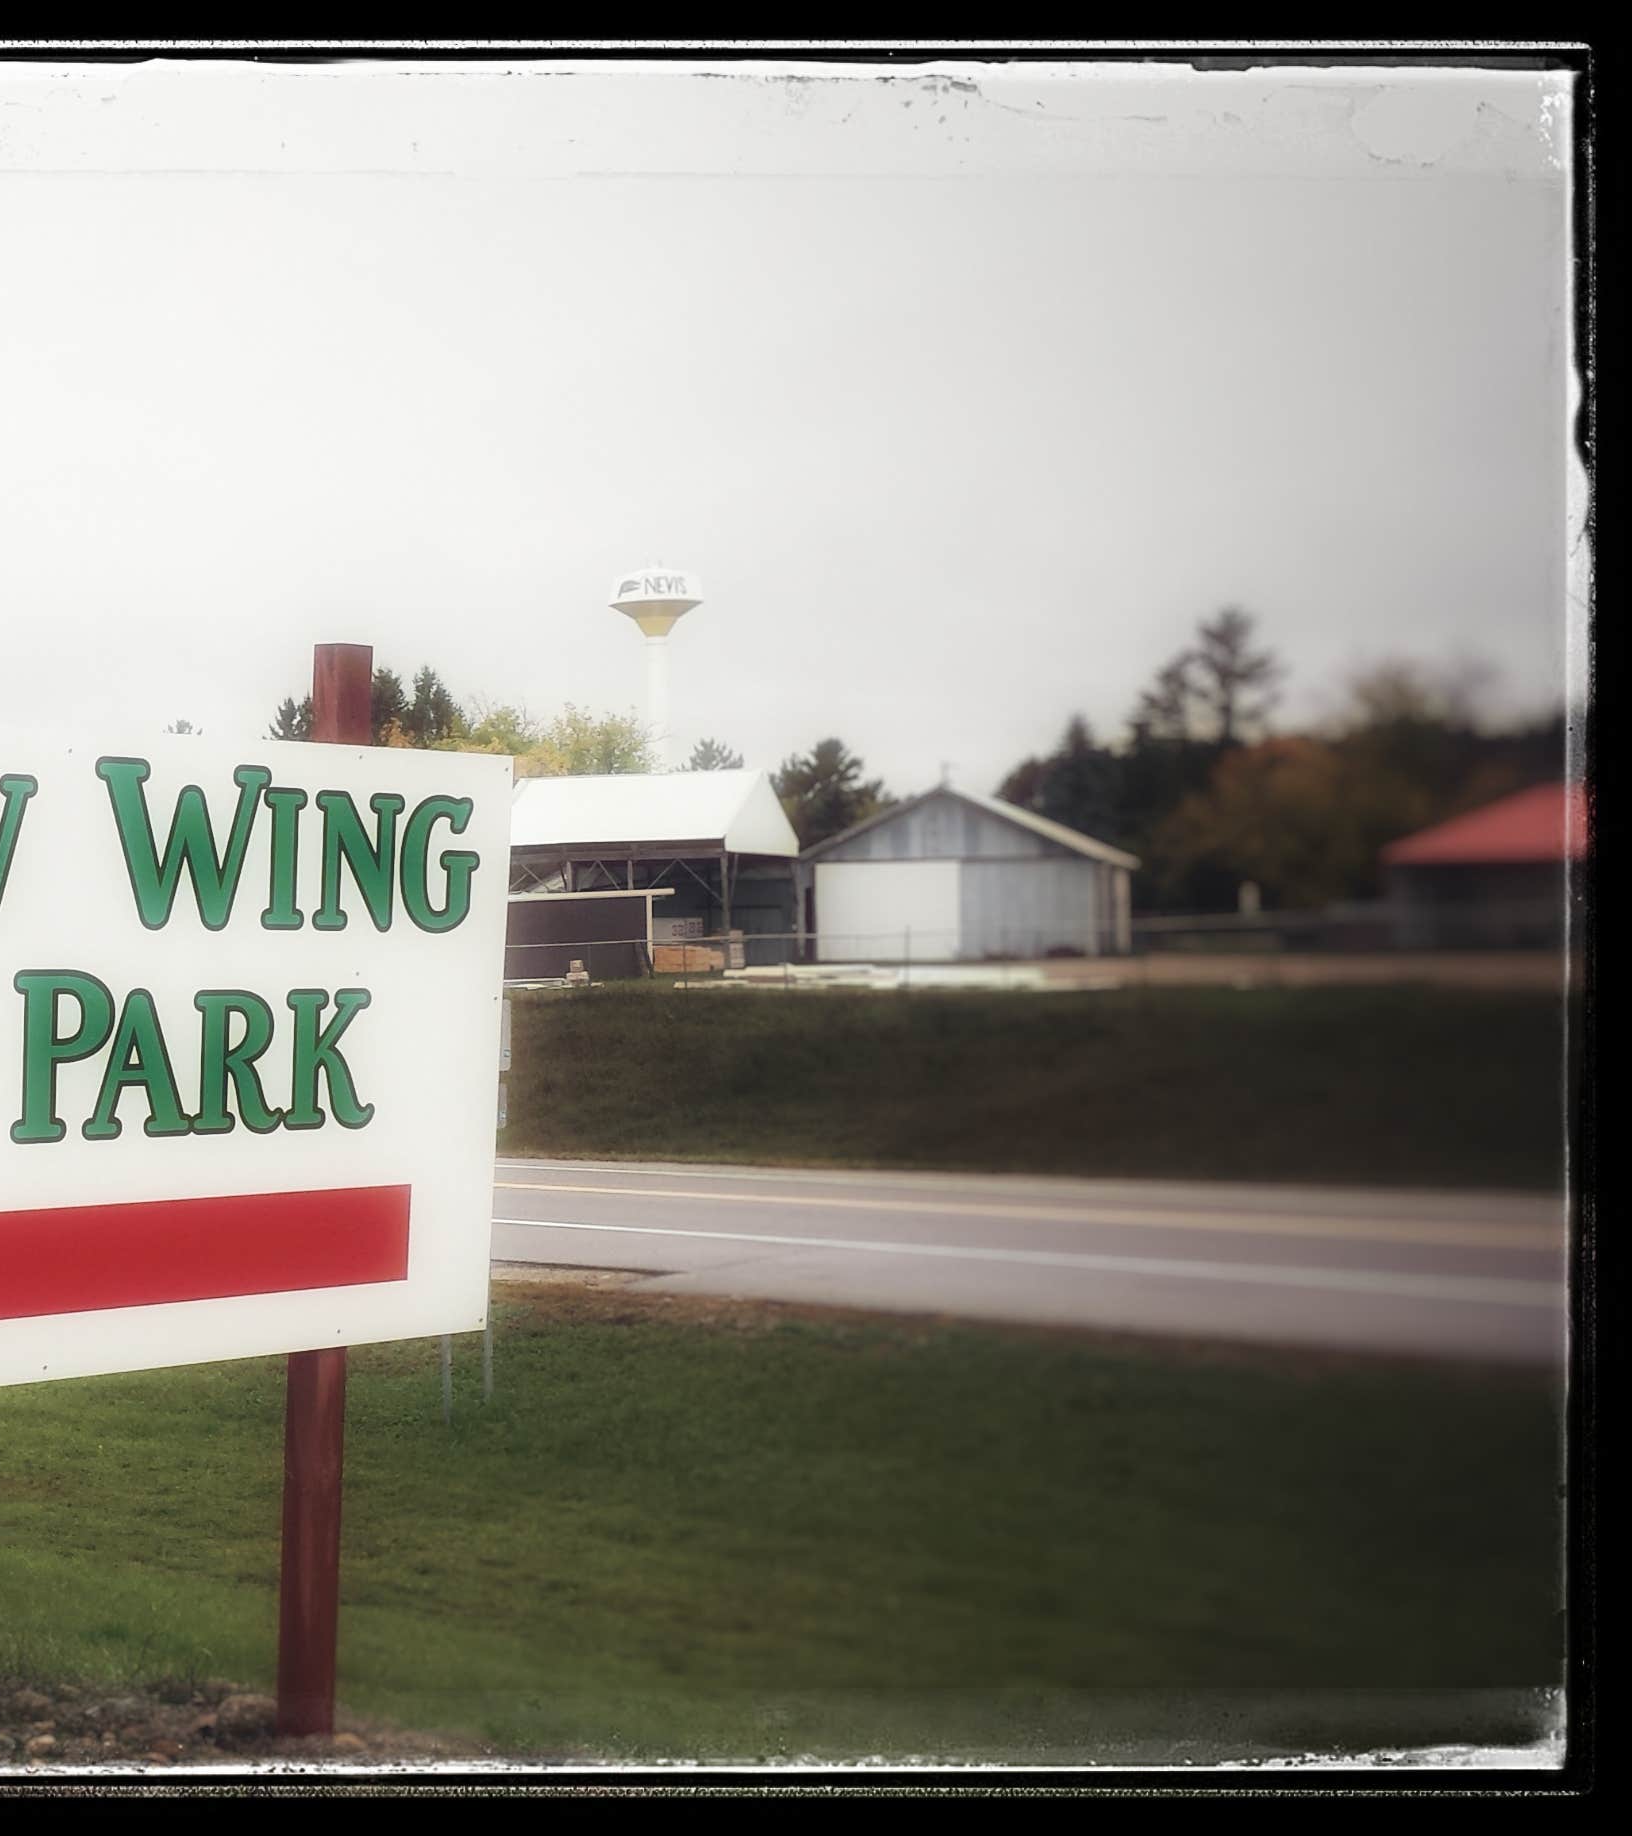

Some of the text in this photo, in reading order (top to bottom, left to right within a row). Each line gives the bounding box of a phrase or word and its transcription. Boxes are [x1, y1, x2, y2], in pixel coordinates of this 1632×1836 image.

[644, 575, 687, 595] NEVIS
[95, 756, 480, 933] WING
[10, 969, 374, 1144] PARK
